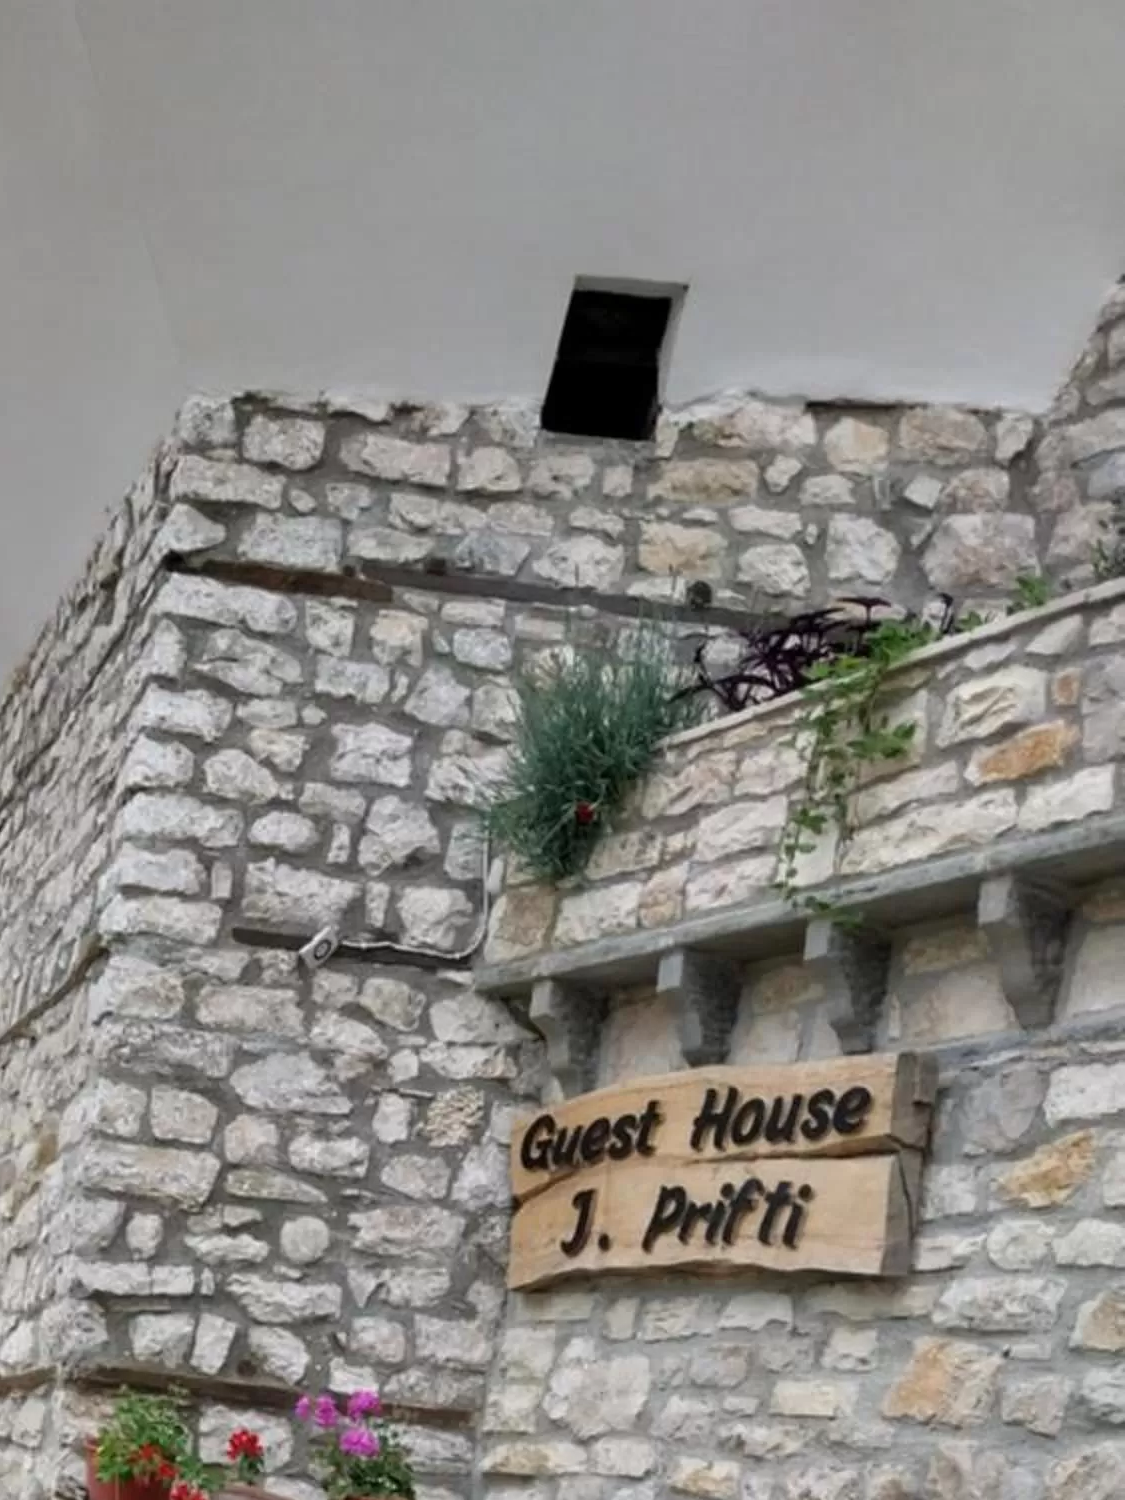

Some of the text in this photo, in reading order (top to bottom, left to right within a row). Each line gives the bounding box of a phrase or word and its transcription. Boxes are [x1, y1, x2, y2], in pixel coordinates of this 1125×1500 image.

[520, 1085, 873, 1173] Guest House
[560, 1178, 815, 1258] J. Prifti
